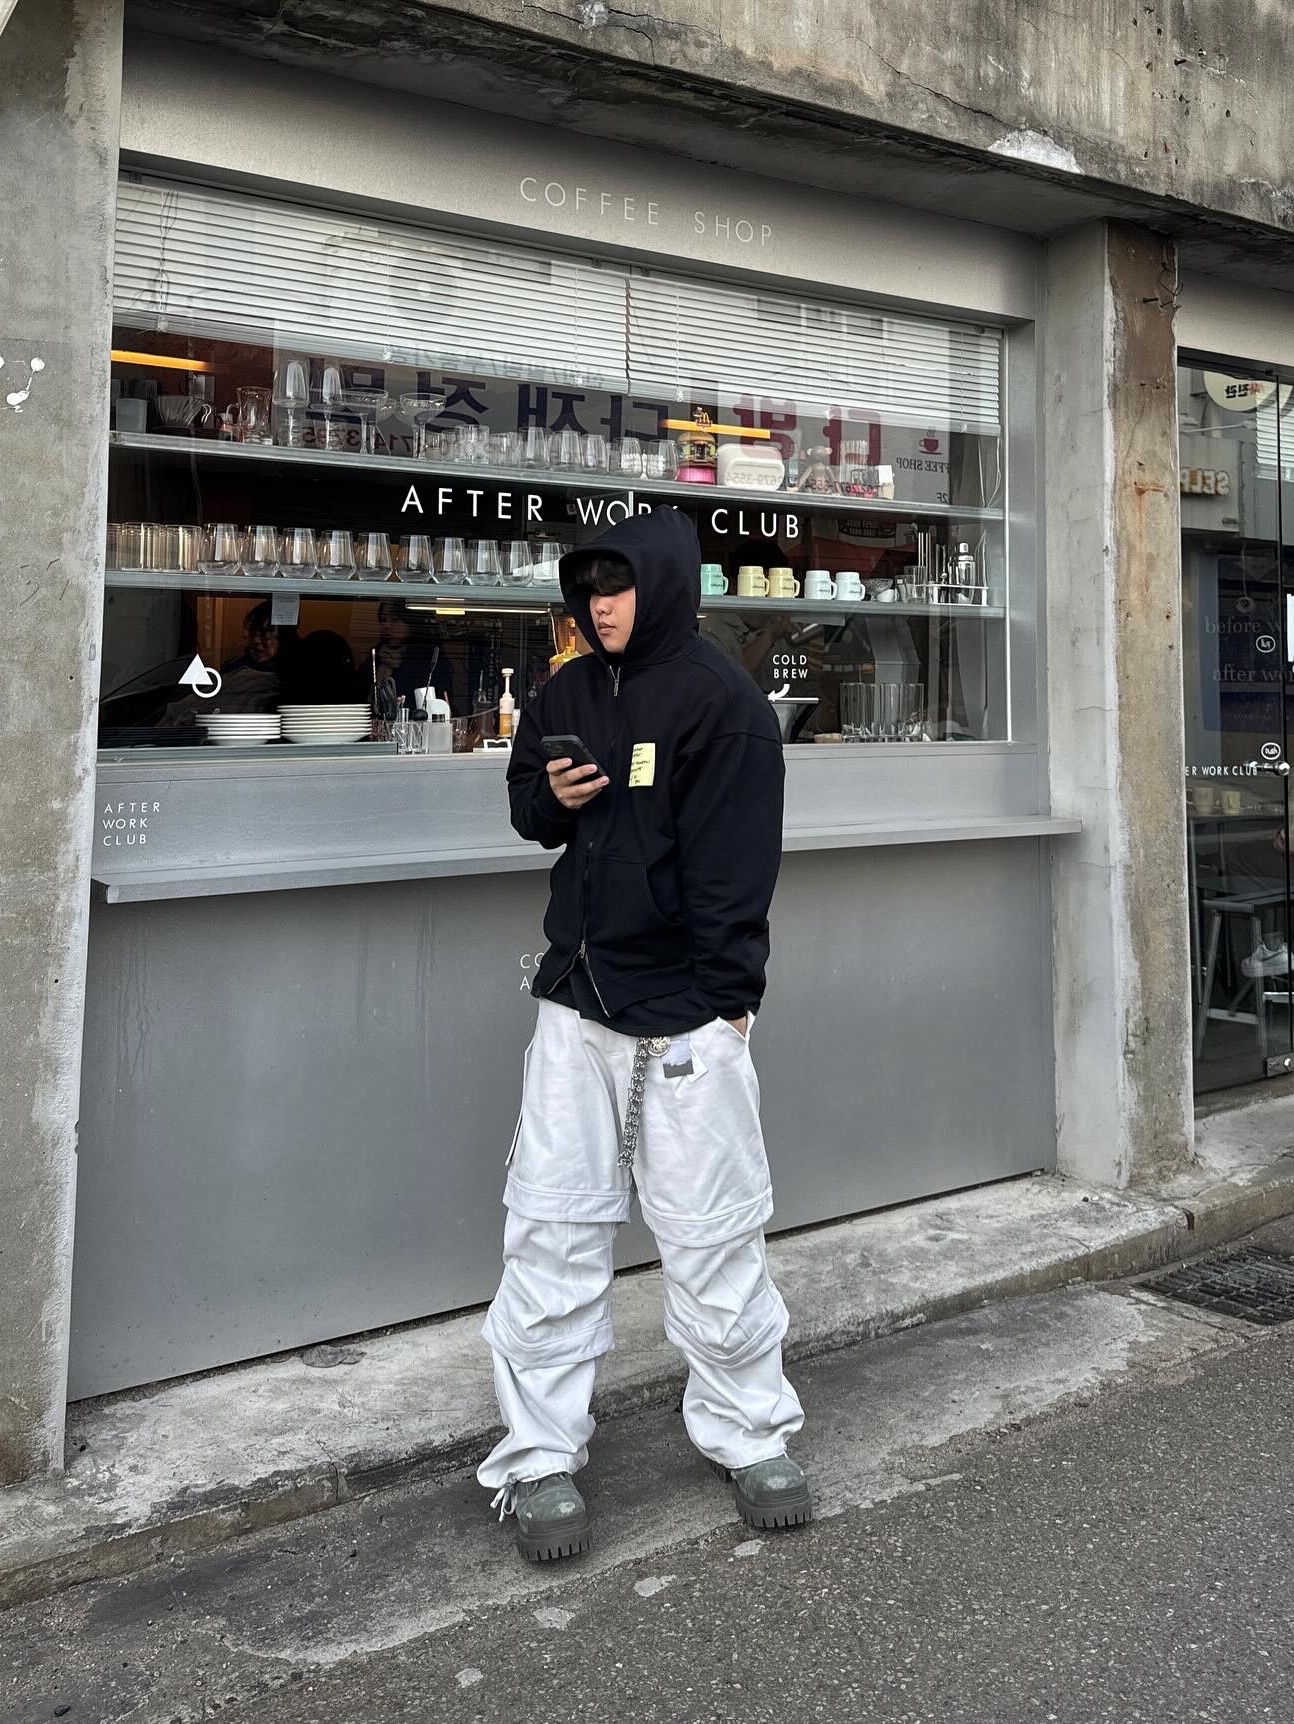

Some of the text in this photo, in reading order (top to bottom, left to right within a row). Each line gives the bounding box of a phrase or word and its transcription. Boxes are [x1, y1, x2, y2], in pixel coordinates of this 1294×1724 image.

[519, 176, 773, 246] COFFEE SHOP
[400, 484, 544, 522] AFTER
[711, 508, 800, 540] CLUB
[772, 654, 807, 665] COLD
[773, 668, 808, 679] BREW
[1213, 664, 1256, 682] after
[1201, 765, 1229, 776] WORK
[1232, 765, 1258, 776] CLUB
[104, 802, 160, 813] AFTER
[102, 817, 148, 830] WORK
[103, 833, 147, 846] CLUB
